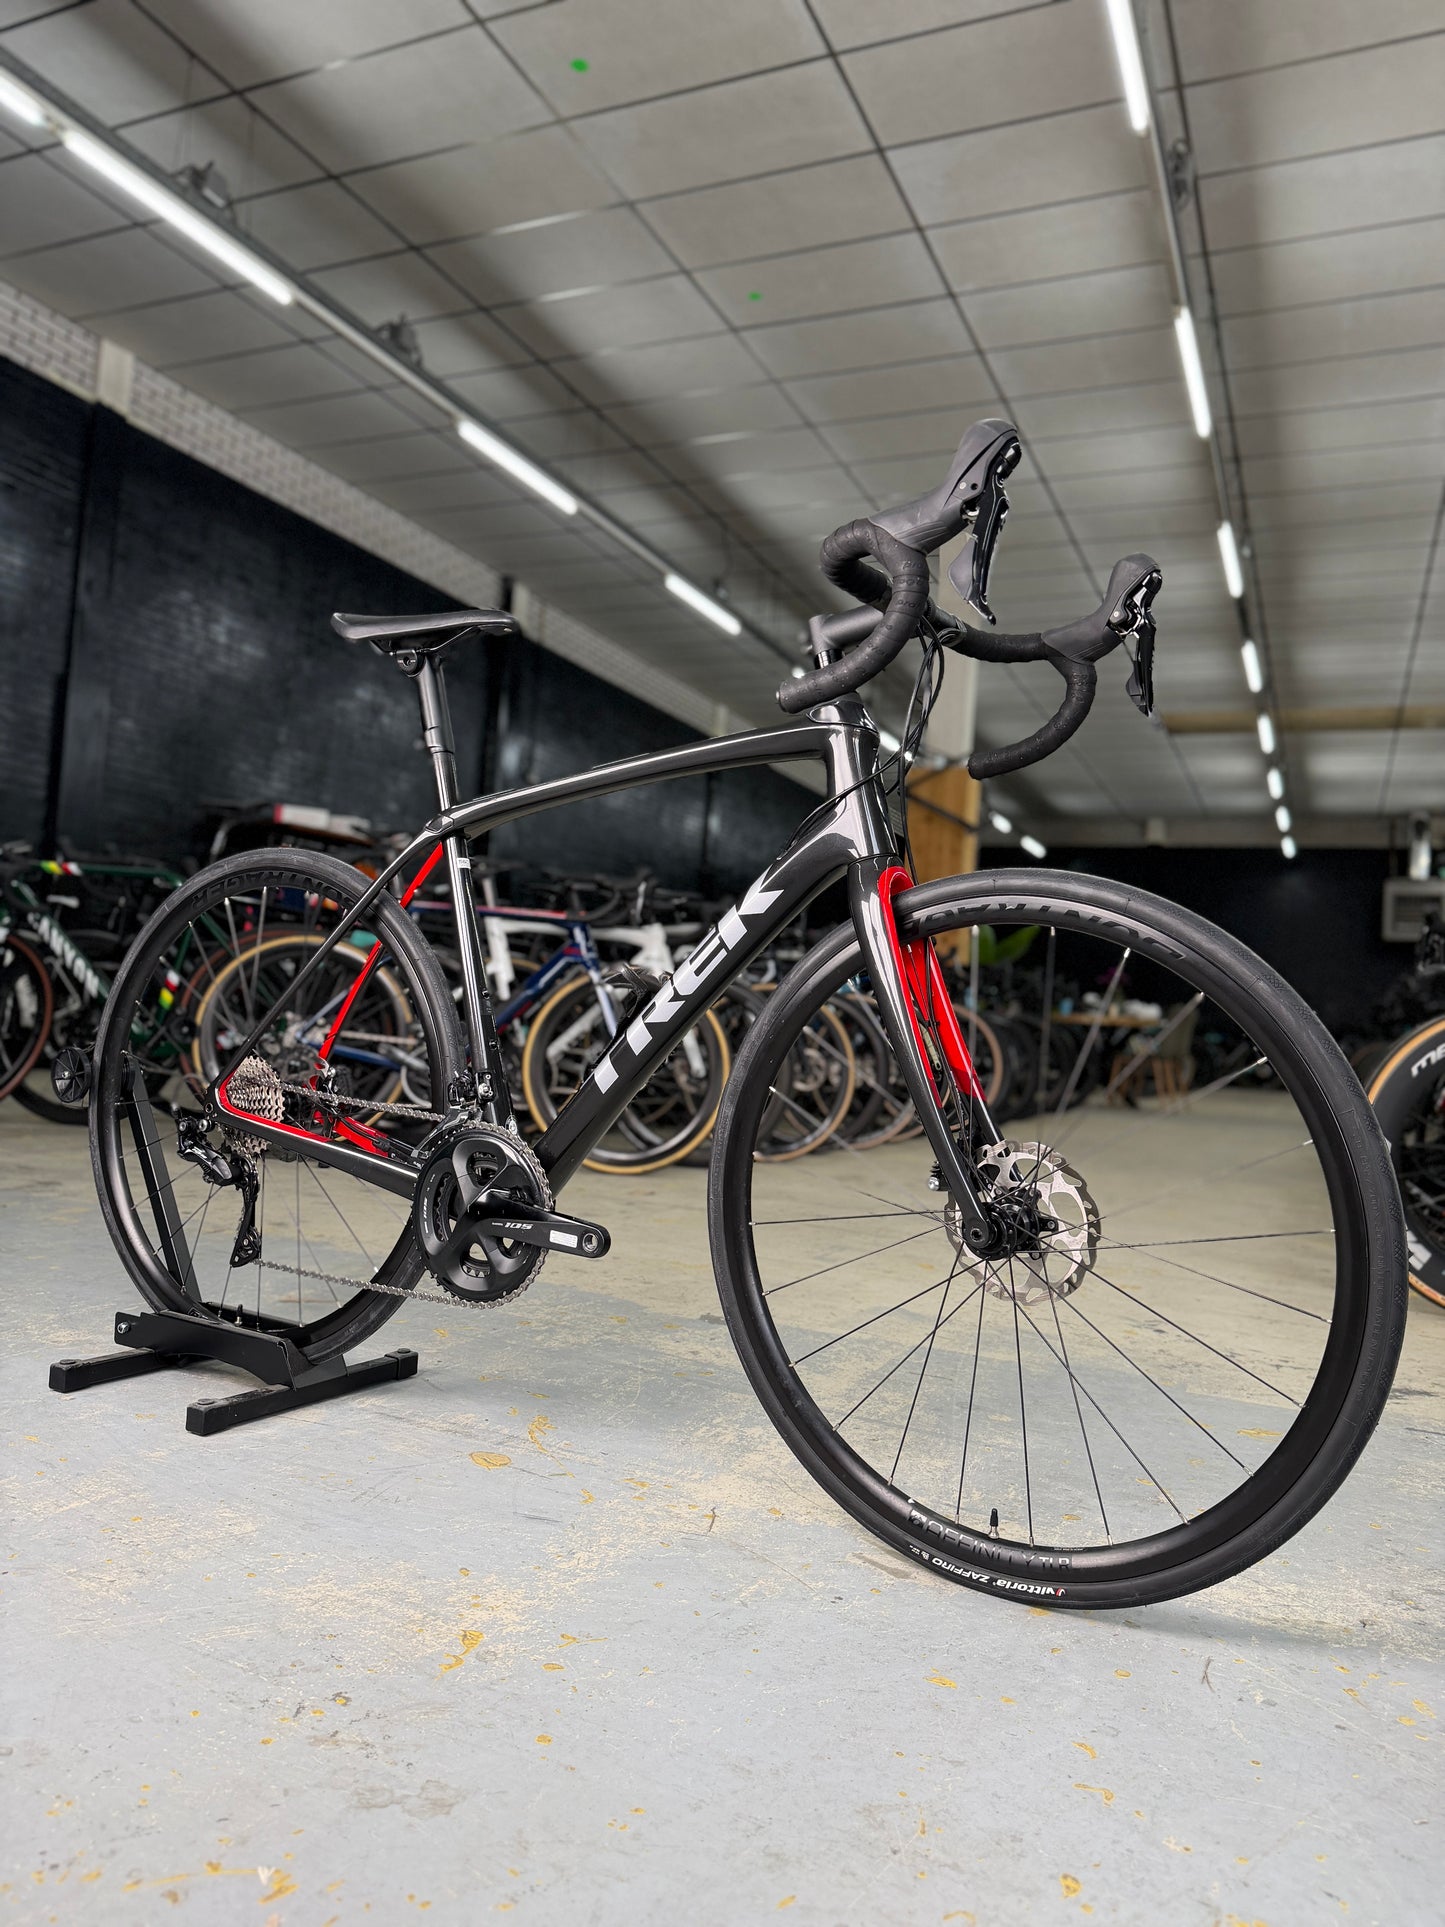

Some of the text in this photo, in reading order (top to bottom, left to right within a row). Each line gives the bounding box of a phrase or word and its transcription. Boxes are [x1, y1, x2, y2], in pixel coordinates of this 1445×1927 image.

[581, 864, 785, 1094] TREK
[505, 1222, 533, 1230] 105
[927, 1521, 1037, 1567] AFFINITY
[932, 1557, 991, 1583] ZAFFIRO
